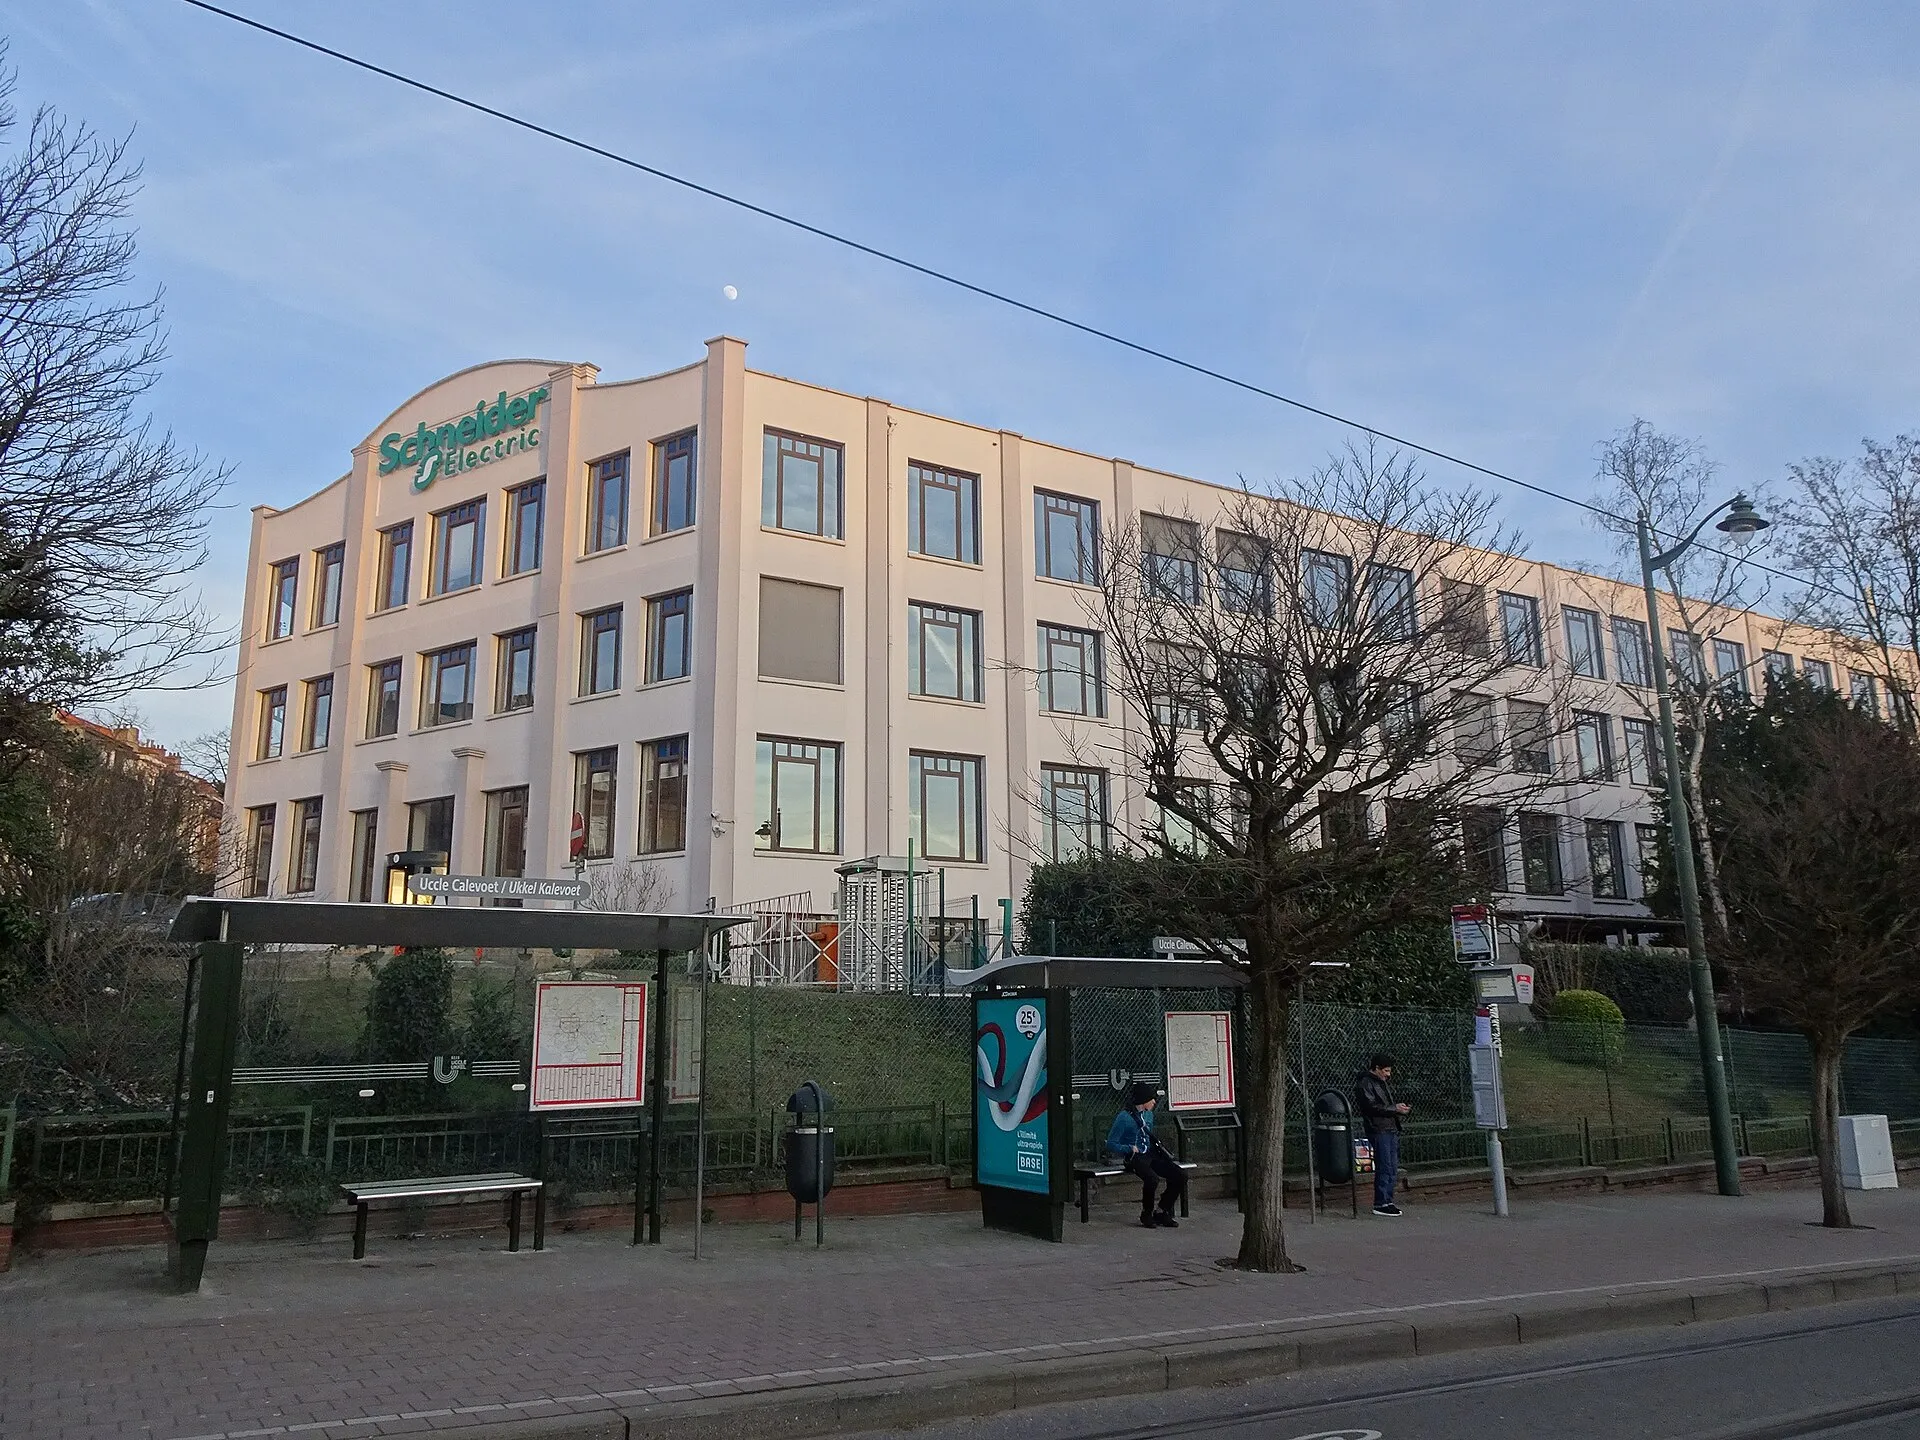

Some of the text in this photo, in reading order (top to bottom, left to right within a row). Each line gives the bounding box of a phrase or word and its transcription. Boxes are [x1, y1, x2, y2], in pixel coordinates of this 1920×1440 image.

[379, 387, 549, 475] Schneider
[444, 428, 540, 476] Electric
[420, 877, 581, 896] Uccle Calevoet / Ukkel Kalevoet
[1159, 939, 1175, 950] Uccle
[1020, 1156, 1041, 1170] BASE
